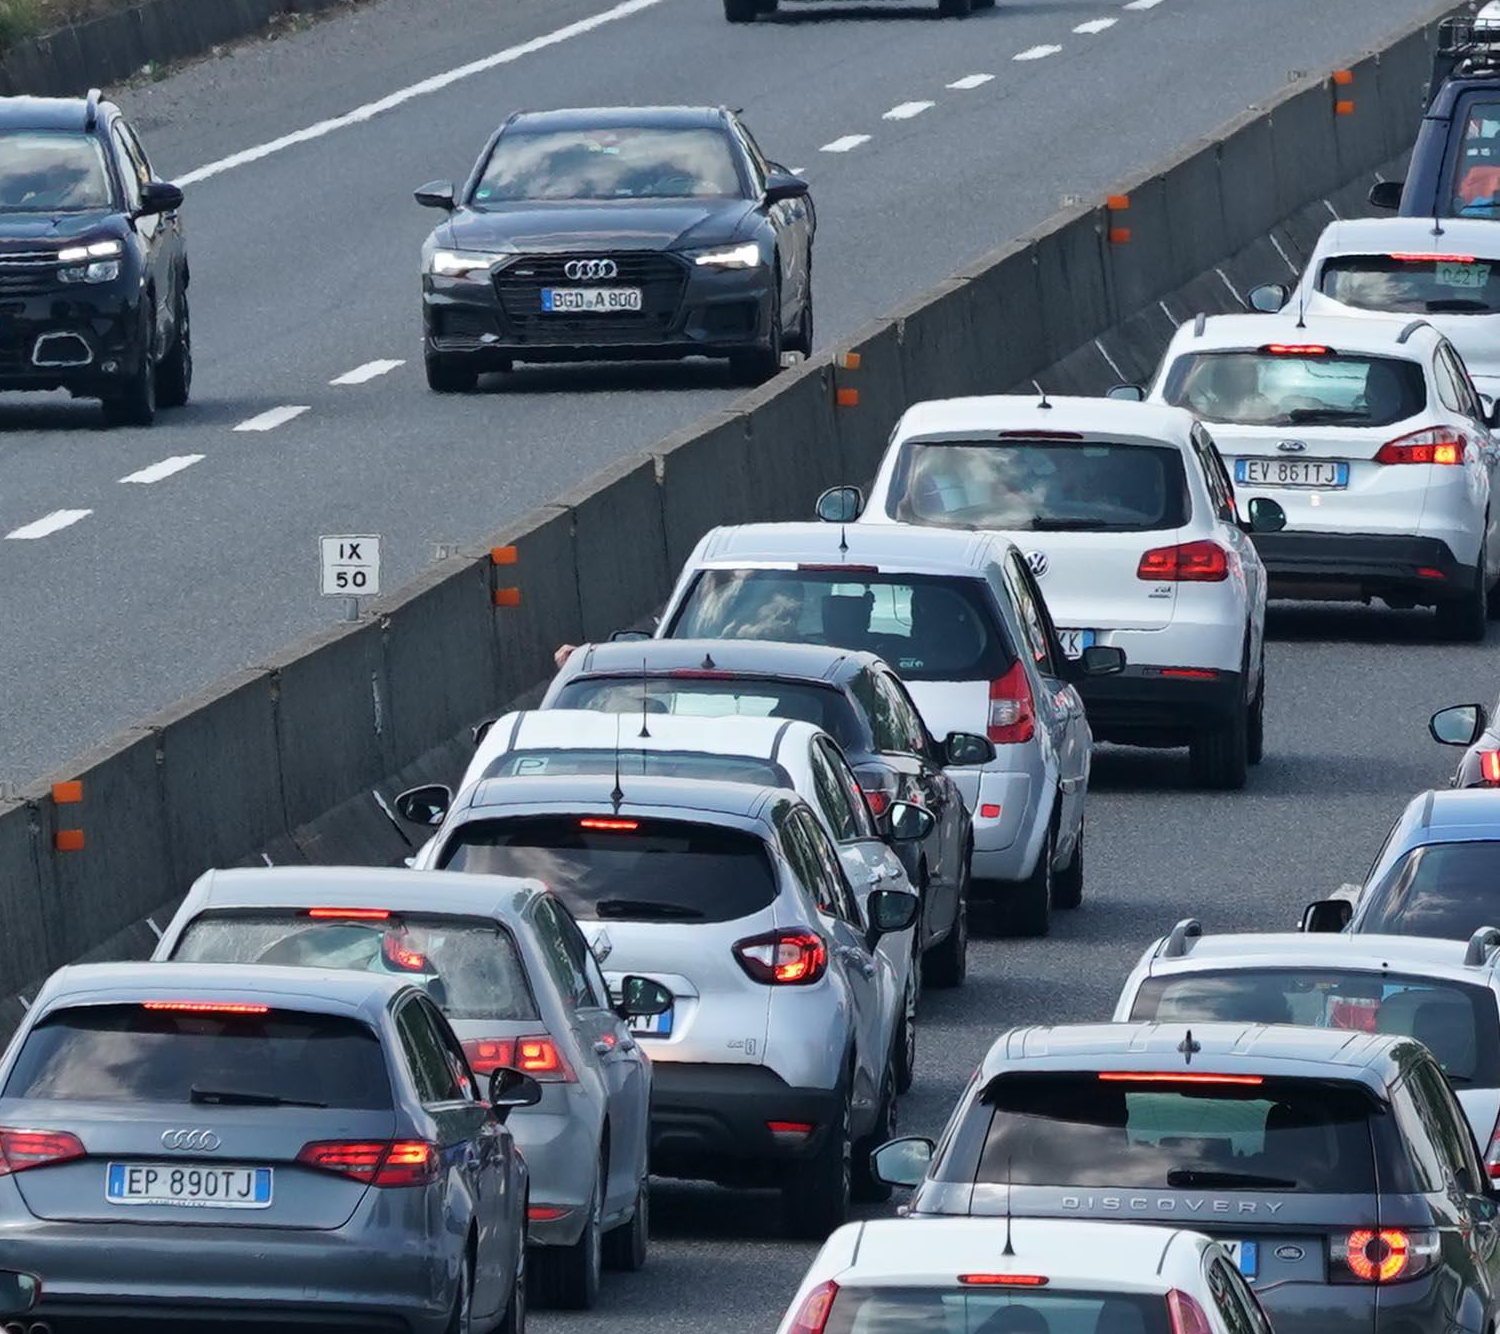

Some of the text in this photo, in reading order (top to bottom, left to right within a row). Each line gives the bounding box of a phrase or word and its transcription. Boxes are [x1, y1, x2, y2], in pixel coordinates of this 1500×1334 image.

[553, 292, 584, 309] BGD
[593, 291, 606, 308] A
[1248, 461, 1336, 484] EV 861TJ
[339, 542, 362, 560] IX
[336, 571, 367, 588] 50
[127, 1168, 253, 1198] EP 890TJ
[1061, 1195, 1285, 1215] DISCOVERY
